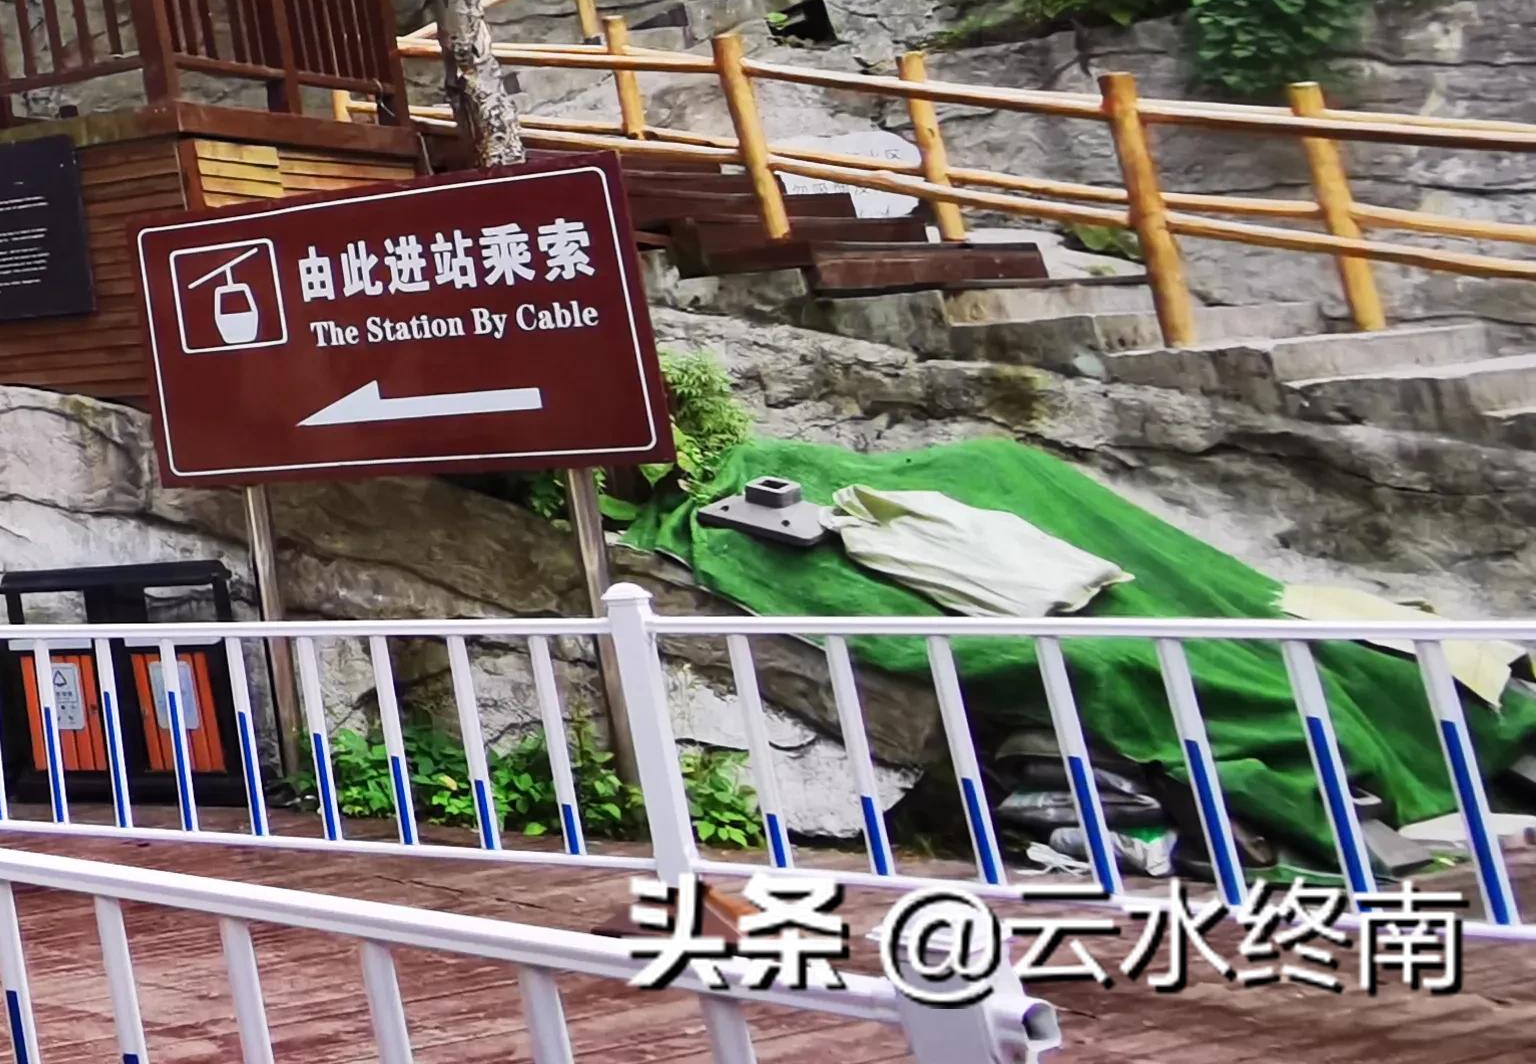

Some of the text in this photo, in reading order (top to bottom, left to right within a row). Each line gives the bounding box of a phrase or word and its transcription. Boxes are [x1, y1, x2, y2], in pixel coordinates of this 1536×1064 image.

[297, 218, 596, 303] 由此进站乘索
[310, 299, 599, 348] The Station By Cable
